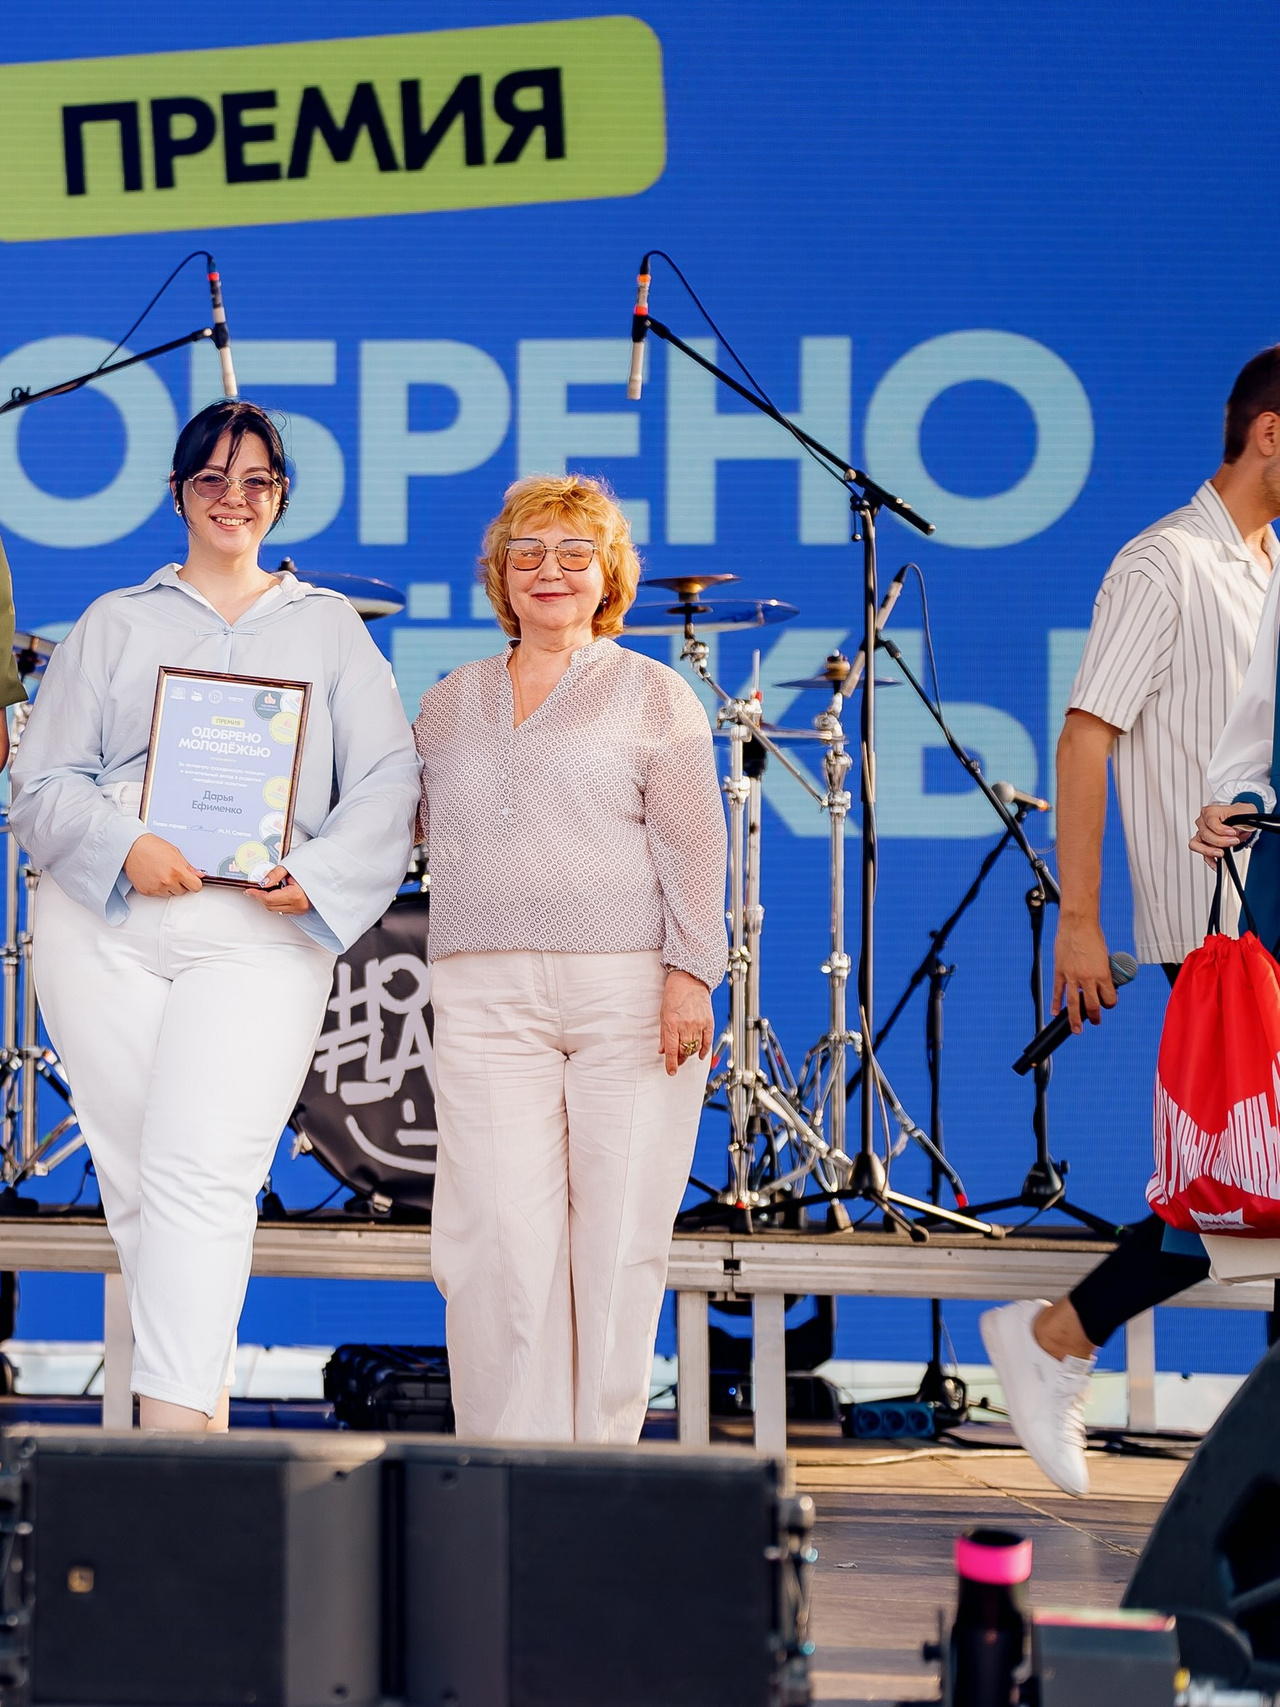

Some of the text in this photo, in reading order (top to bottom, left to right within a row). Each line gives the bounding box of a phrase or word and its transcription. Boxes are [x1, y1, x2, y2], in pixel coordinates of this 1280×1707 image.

[61, 66, 566, 197] ПРЕМИЯ
[215, 718, 241, 726] ПРЕМИЯ
[191, 726, 262, 744] ОДОБРЕНО
[178, 738, 271, 758] МОЛОДЁЖЬЮ
[202, 790, 234, 803] Дарья
[191, 800, 243, 815] Ефименко
